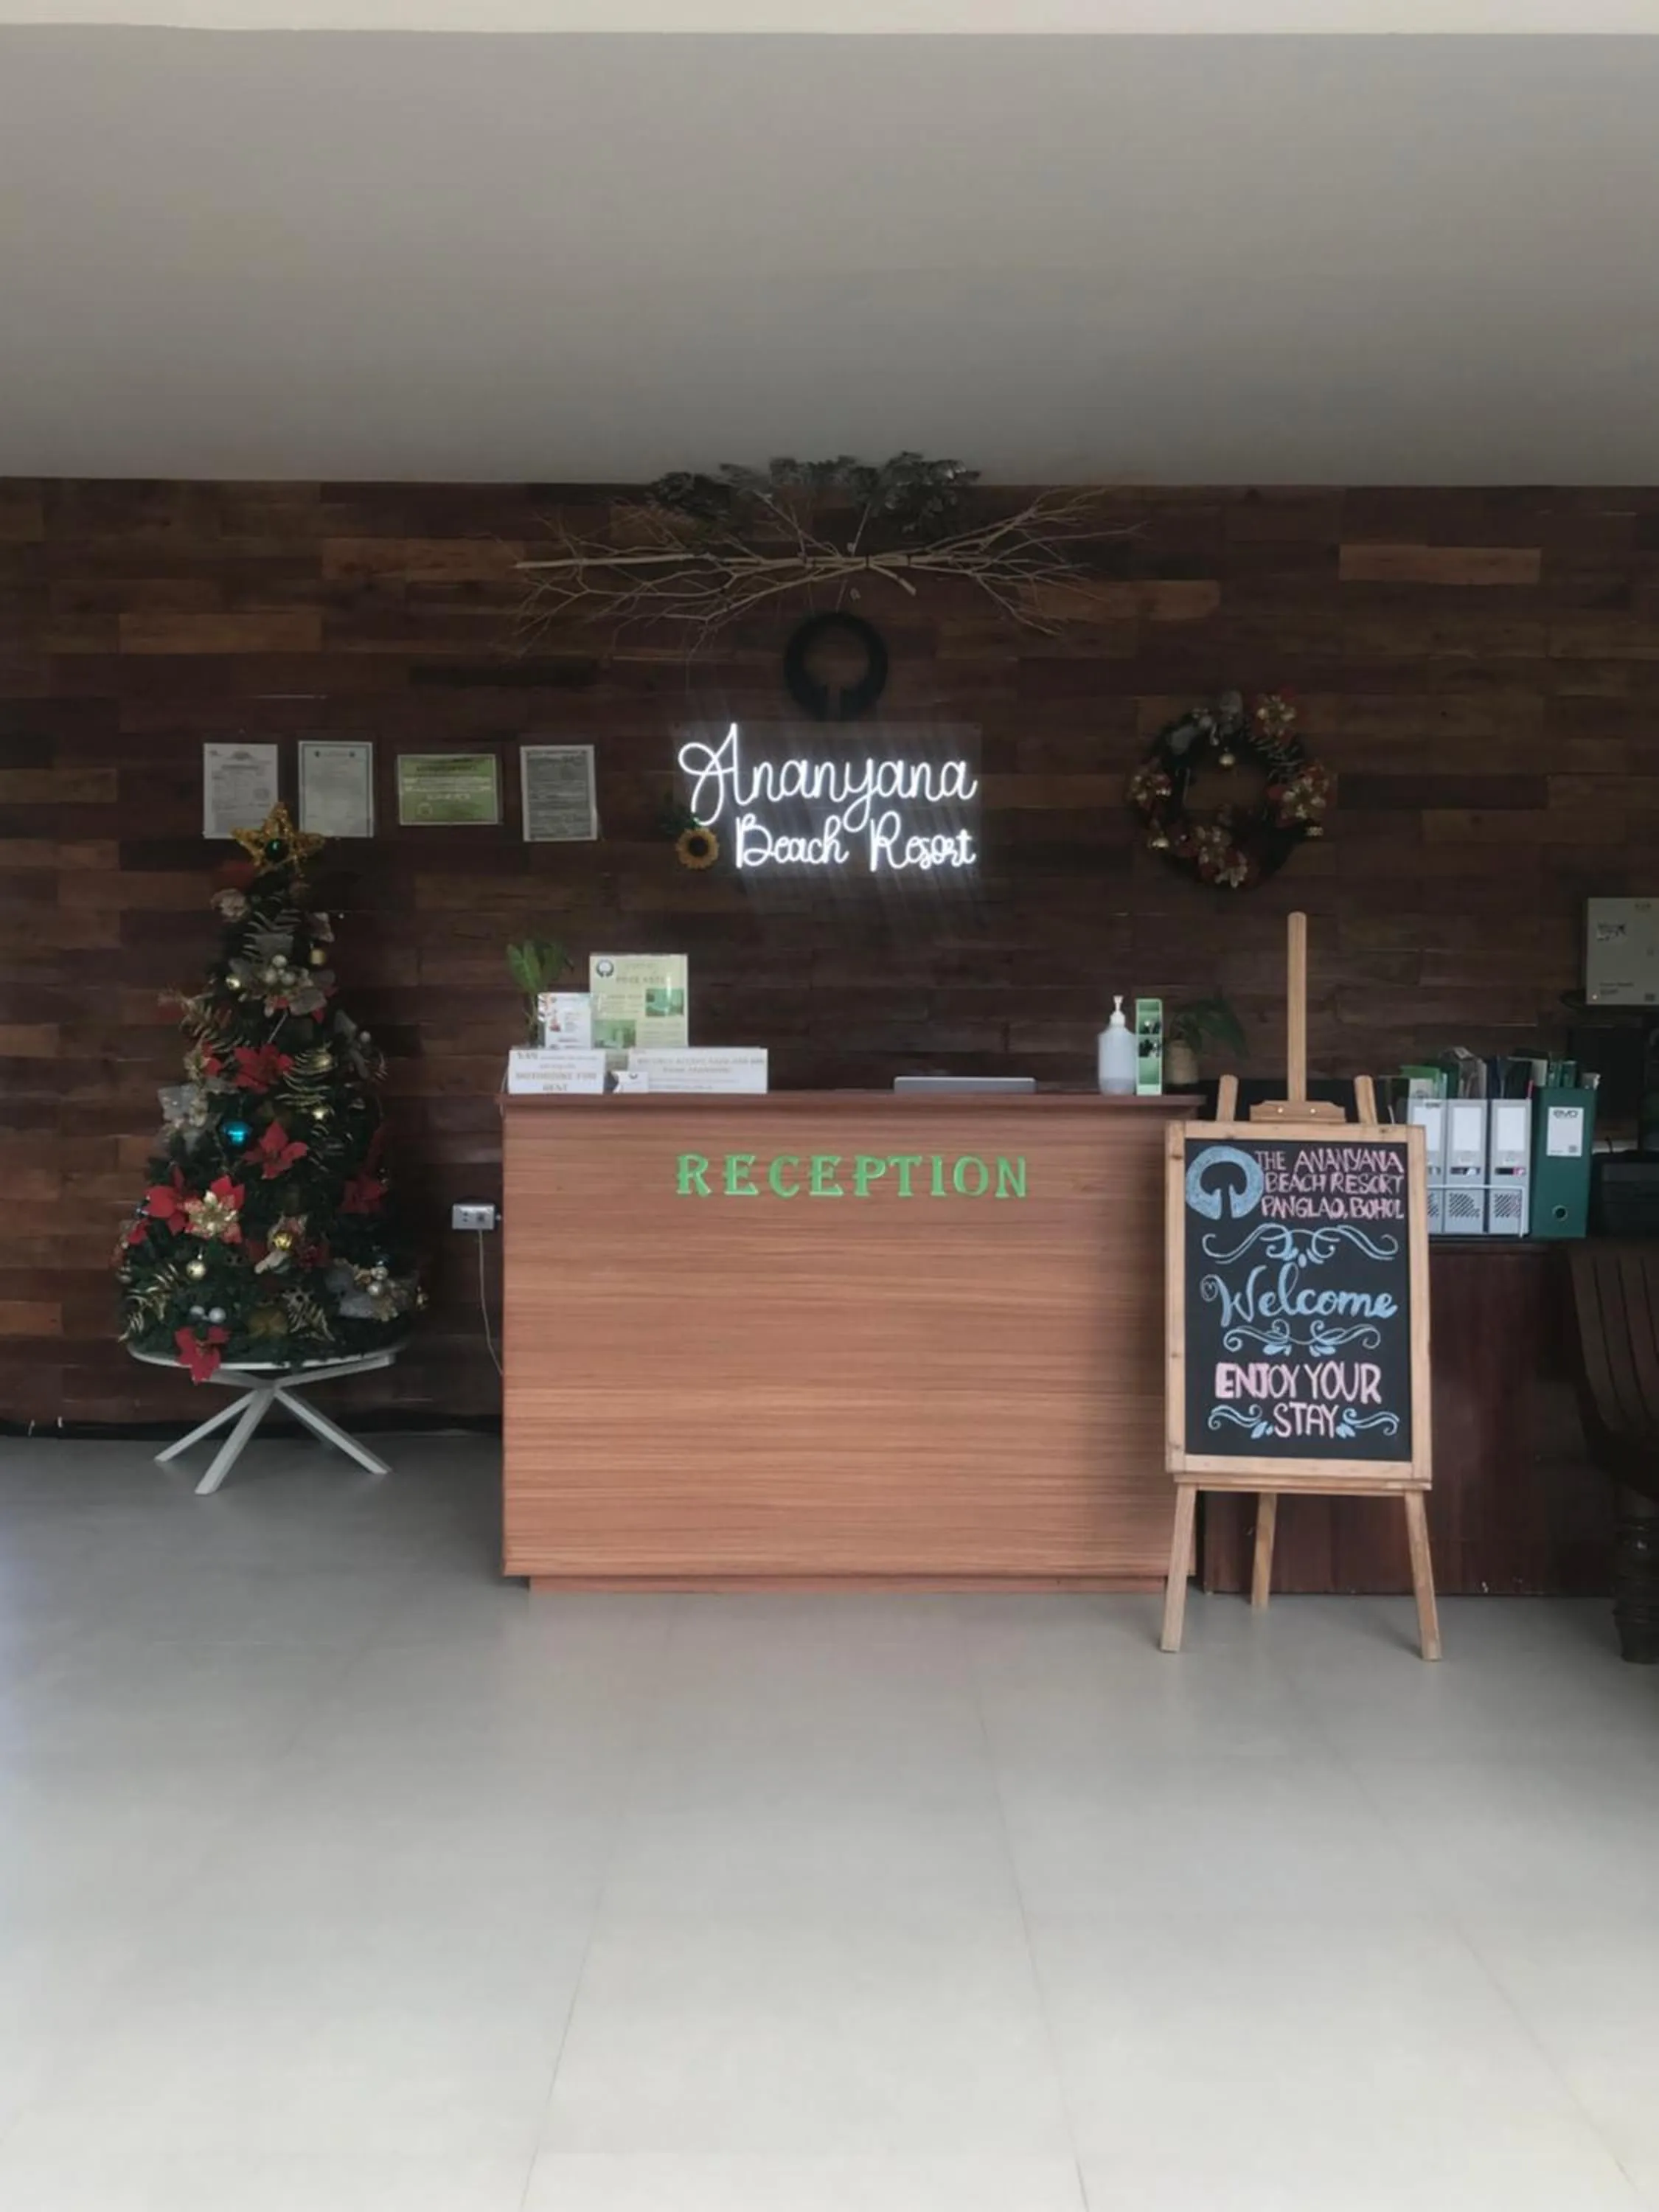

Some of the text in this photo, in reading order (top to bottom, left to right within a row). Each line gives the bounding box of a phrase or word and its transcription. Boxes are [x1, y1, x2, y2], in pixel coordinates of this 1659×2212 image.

[678, 722, 978, 832] Ananyana
[736, 810, 976, 872] Beach Resort
[675, 1153, 1028, 1198] RECEPTION
[1255, 1147, 1405, 1174] THE ANANYANA
[1265, 1171, 1405, 1195] BEACH RESORT
[1349, 1197, 1405, 1220] BOHOL
[1200, 1262, 1399, 1327] Welcome
[1214, 1361, 1382, 1404] ENJOY YOUR
[1273, 1402, 1339, 1439] STAY
